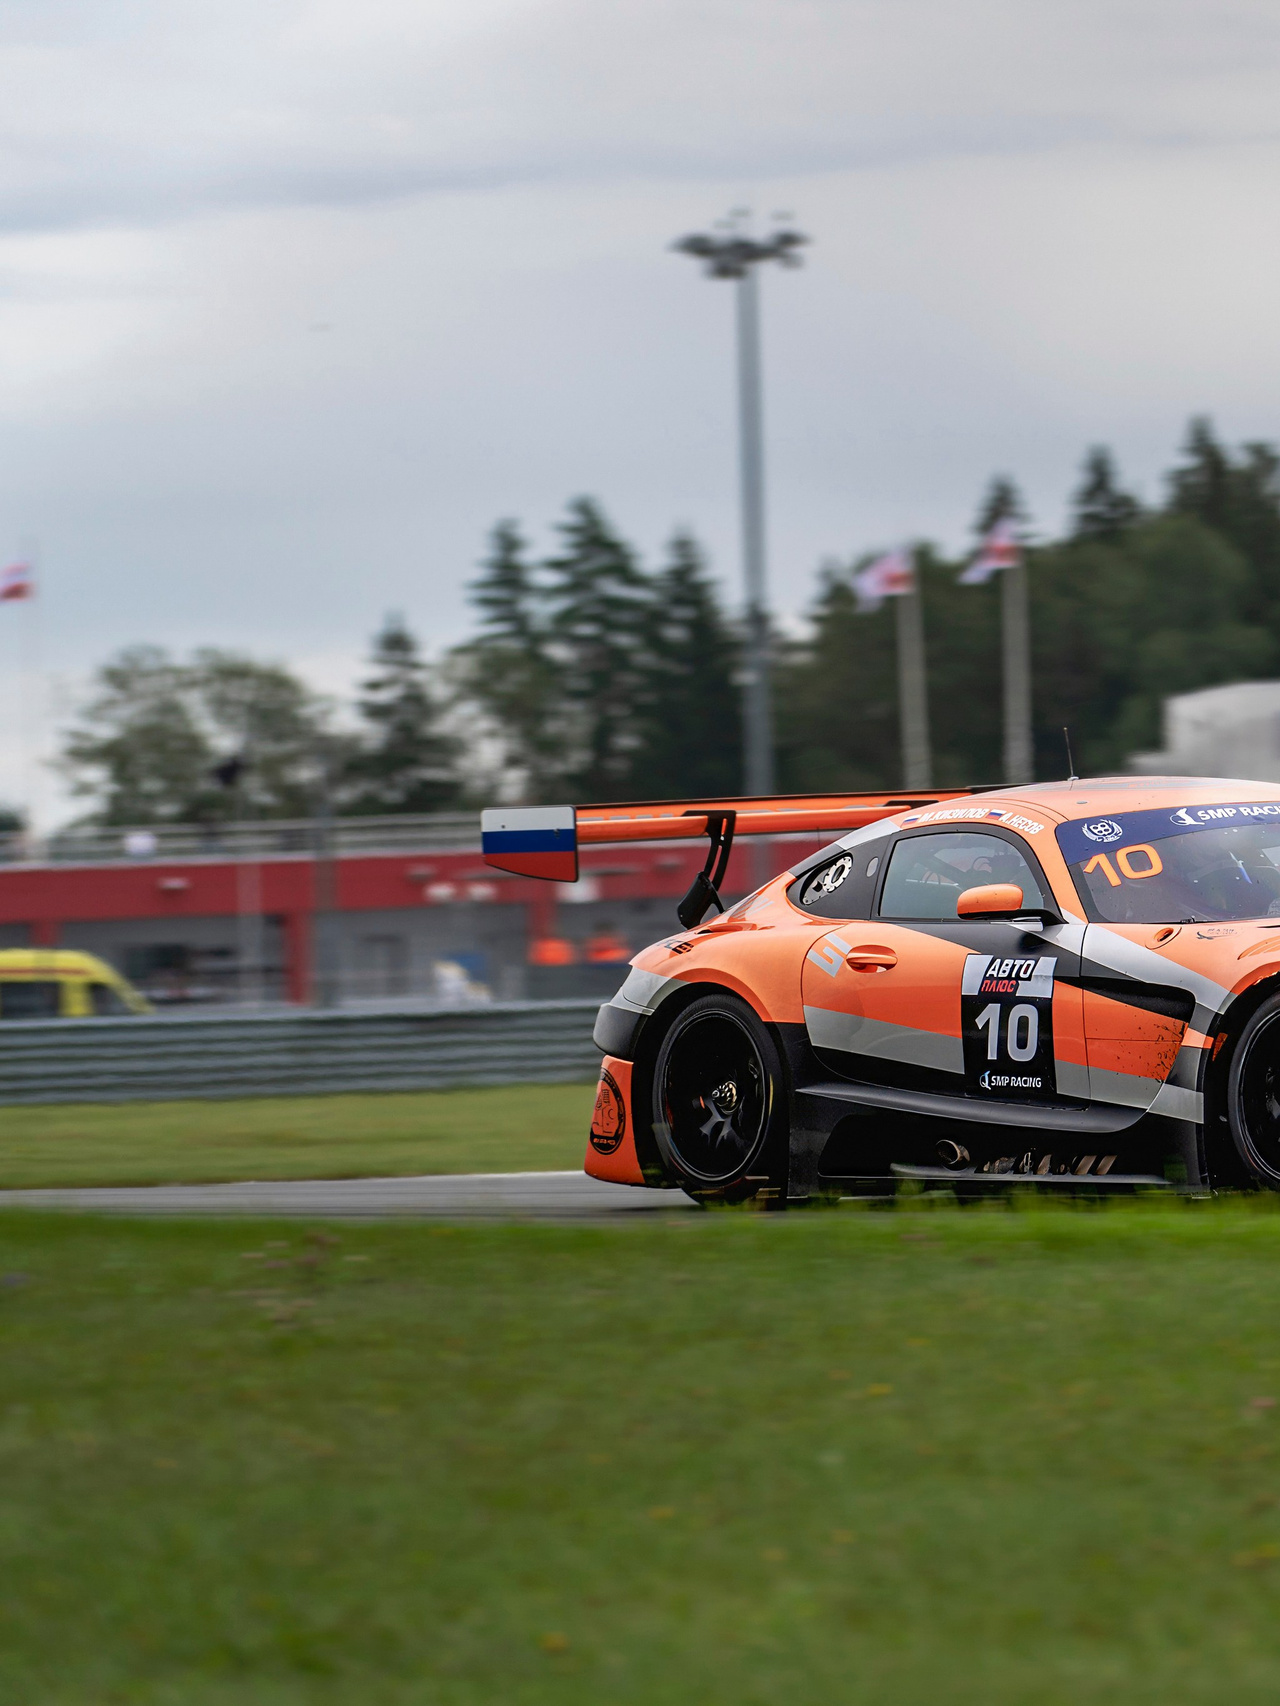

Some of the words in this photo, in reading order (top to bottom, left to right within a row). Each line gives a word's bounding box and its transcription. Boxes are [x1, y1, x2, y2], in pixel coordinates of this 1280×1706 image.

[1197, 807, 1238, 821] SMP
[1083, 843, 1164, 888] 10
[986, 958, 1036, 979] АВТО
[981, 980, 1017, 993] ПЛЮС
[975, 1003, 1039, 1062] 10
[991, 1075, 1009, 1087] SMP
[1010, 1076, 1042, 1088] RACING
